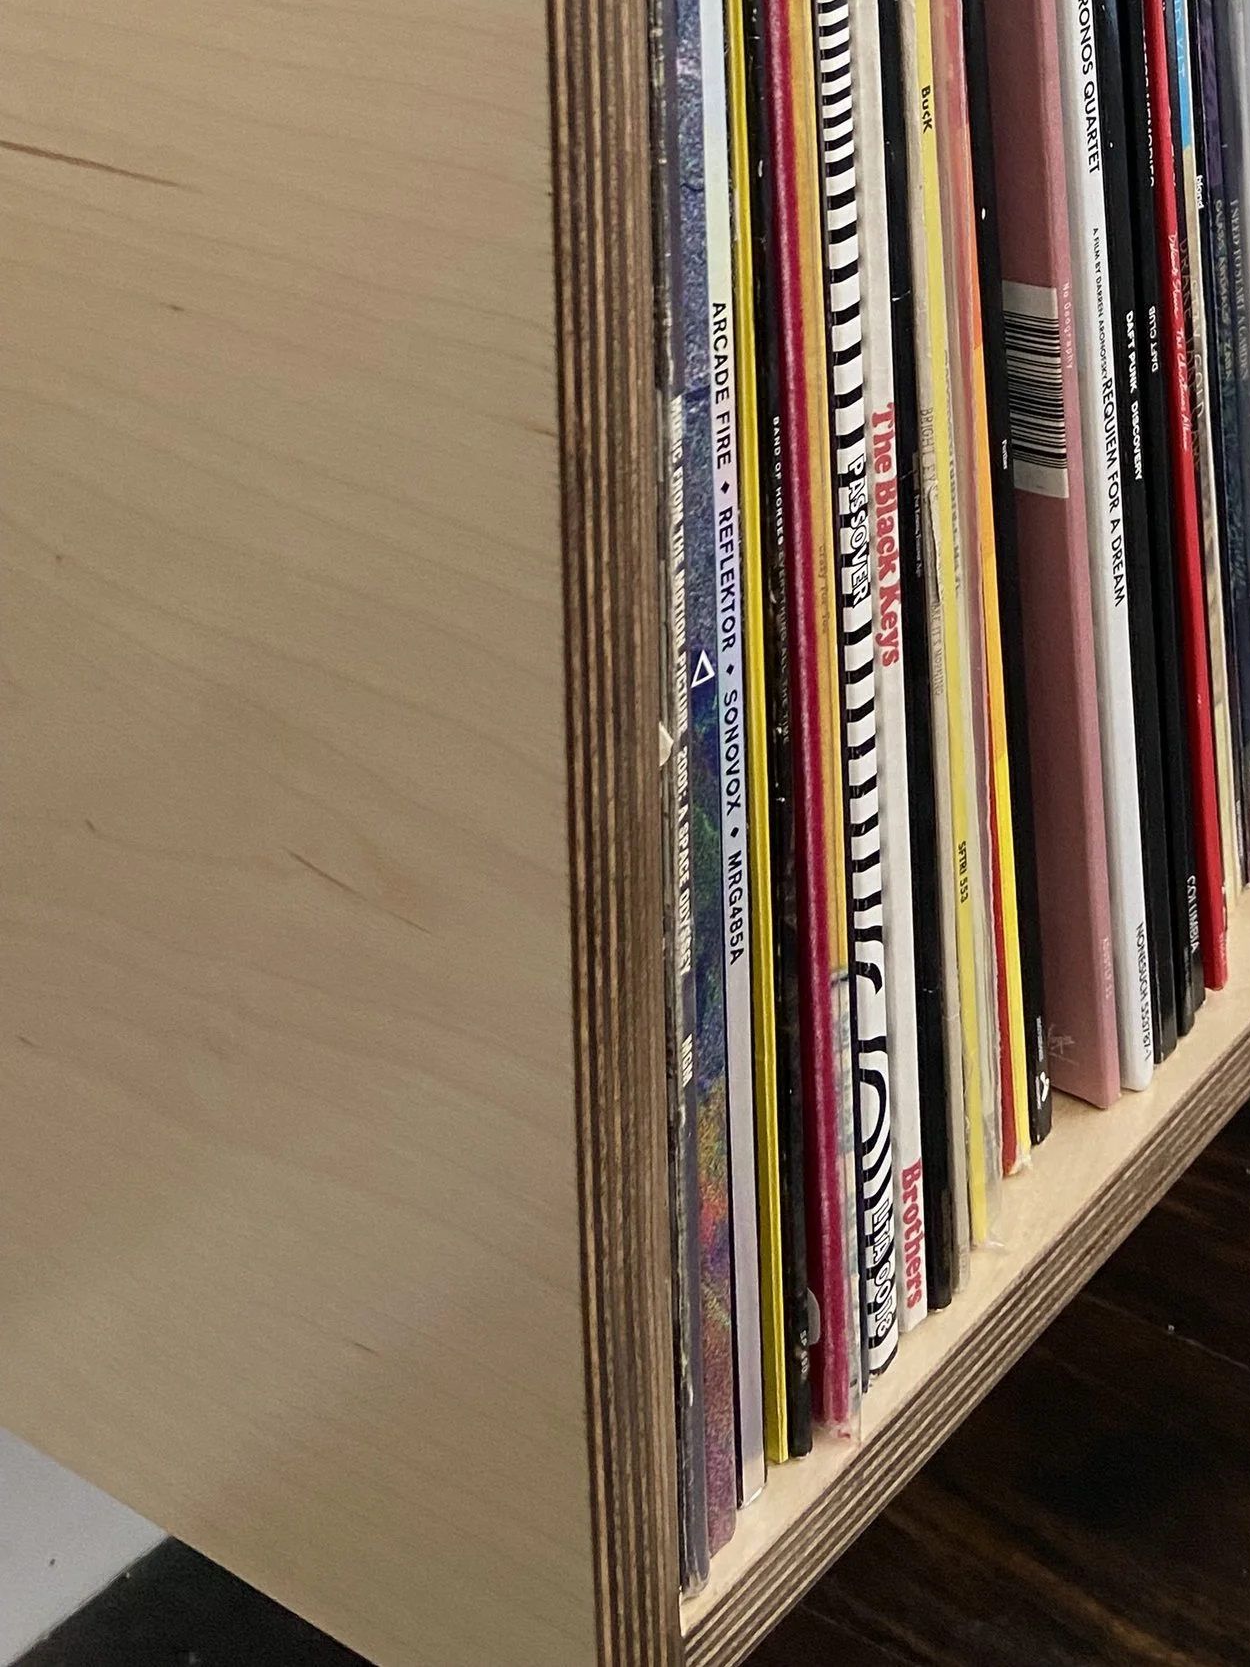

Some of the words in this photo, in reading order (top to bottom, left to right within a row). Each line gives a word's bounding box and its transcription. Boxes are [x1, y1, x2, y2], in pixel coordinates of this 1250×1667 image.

[1082, 80, 1100, 174] QUARTET
[1196, 174, 1205, 209] blond
[1214, 198, 1226, 248] GLASS
[1231, 207, 1240, 245] NEED
[1062, 282, 1070, 298] No
[1094, 261, 1101, 273] BY
[1179, 238, 1192, 319] DRAKE
[1218, 256, 1231, 324] ANIMALS
[1233, 270, 1245, 310] START
[1095, 276, 1104, 316] DARREN
[1148, 306, 1157, 339] CLUB
[1236, 314, 1245, 325] A
[712, 302, 730, 405] ARCADE
[1063, 301, 1074, 369] Geography
[1097, 319, 1108, 379] ARONOFSKY
[1125, 309, 1136, 349] DAFT
[1150, 342, 1159, 372] DAFT
[1238, 325, 1249, 380] GARDEN
[1127, 351, 1138, 394] PUNK
[670, 394, 683, 465] MUSIC
[715, 413, 732, 470] FIRE
[772, 416, 780, 456] BAND
[871, 403, 896, 474] The
[919, 407, 935, 459] BRIGHT
[1102, 377, 1117, 470] REQUIEM
[1131, 400, 1143, 481] DISCOVERY
[671, 466, 684, 524] FROM
[774, 462, 781, 481] OF
[1107, 471, 1119, 512] FOR
[673, 525, 685, 563] THE
[775, 486, 784, 546] HORSES
[847, 452, 870, 610] PASSOVER
[873, 475, 901, 582] Black
[1109, 517, 1121, 533] A
[719, 506, 737, 653] REFLEKTOR
[777, 551, 787, 641] EVERYTHING
[1111, 535, 1126, 608] DREAM
[674, 569, 687, 648] MOTION
[875, 577, 902, 667] Keys
[781, 678, 789, 709] THE
[724, 689, 742, 817] SONOVOX
[782, 719, 790, 746] TIME
[676, 745, 688, 801] 2001:
[677, 803, 688, 821] A
[678, 822, 690, 888] SPACE
[957, 840, 967, 875] SFTRI
[728, 850, 745, 966] MRG485A
[959, 879, 969, 904] 553
[1186, 875, 1200, 954] COLUMBIA
[679, 888, 691, 976] ODYSSEY
[1136, 922, 1149, 1000] NONESUCH
[681, 1034, 693, 1088] MGM
[870, 1197, 891, 1264] LITA
[900, 1159, 925, 1309] Brothers
